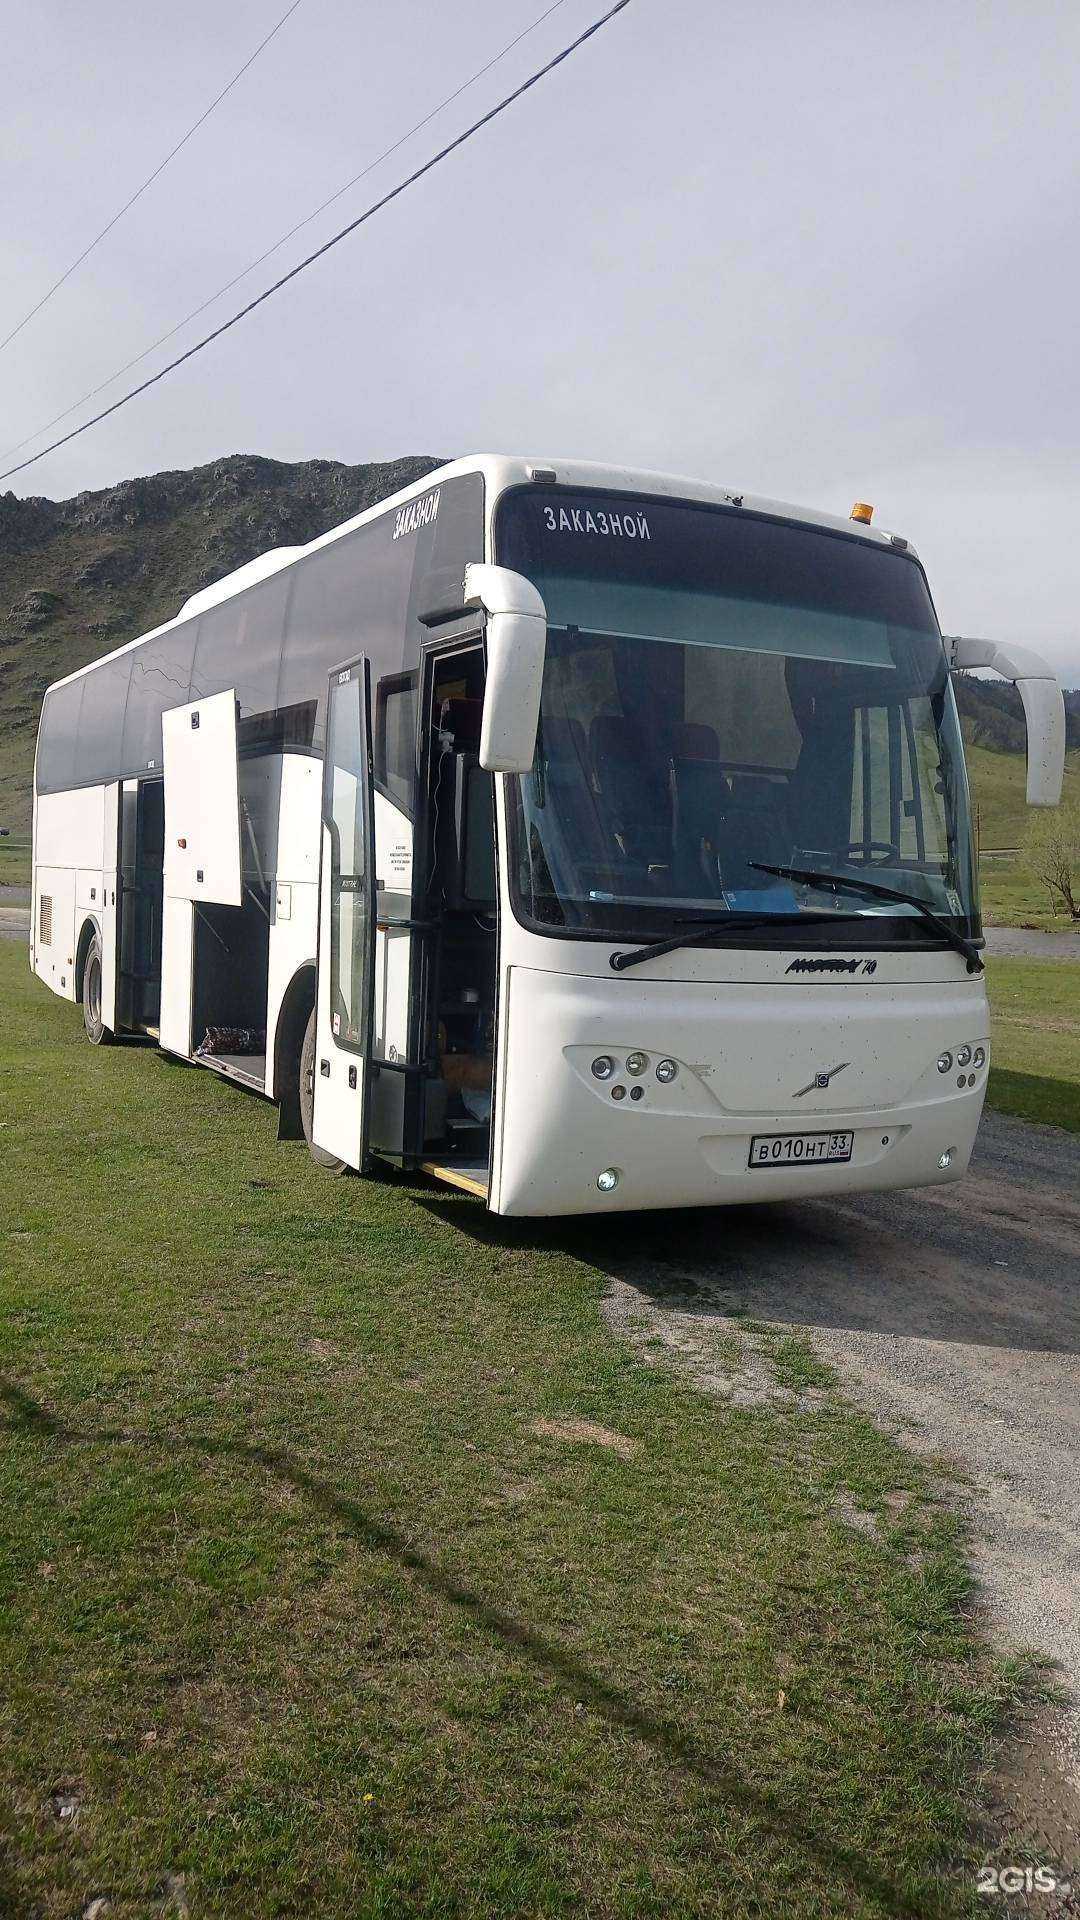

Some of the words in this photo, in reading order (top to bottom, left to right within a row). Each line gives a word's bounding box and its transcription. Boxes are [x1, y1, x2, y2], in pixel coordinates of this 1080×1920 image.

[392, 488, 441, 540] ЗАКАЗНОЙ
[543, 506, 651, 540] ЗАКАЗНОЙ
[831, 1135, 847, 1150] 33
